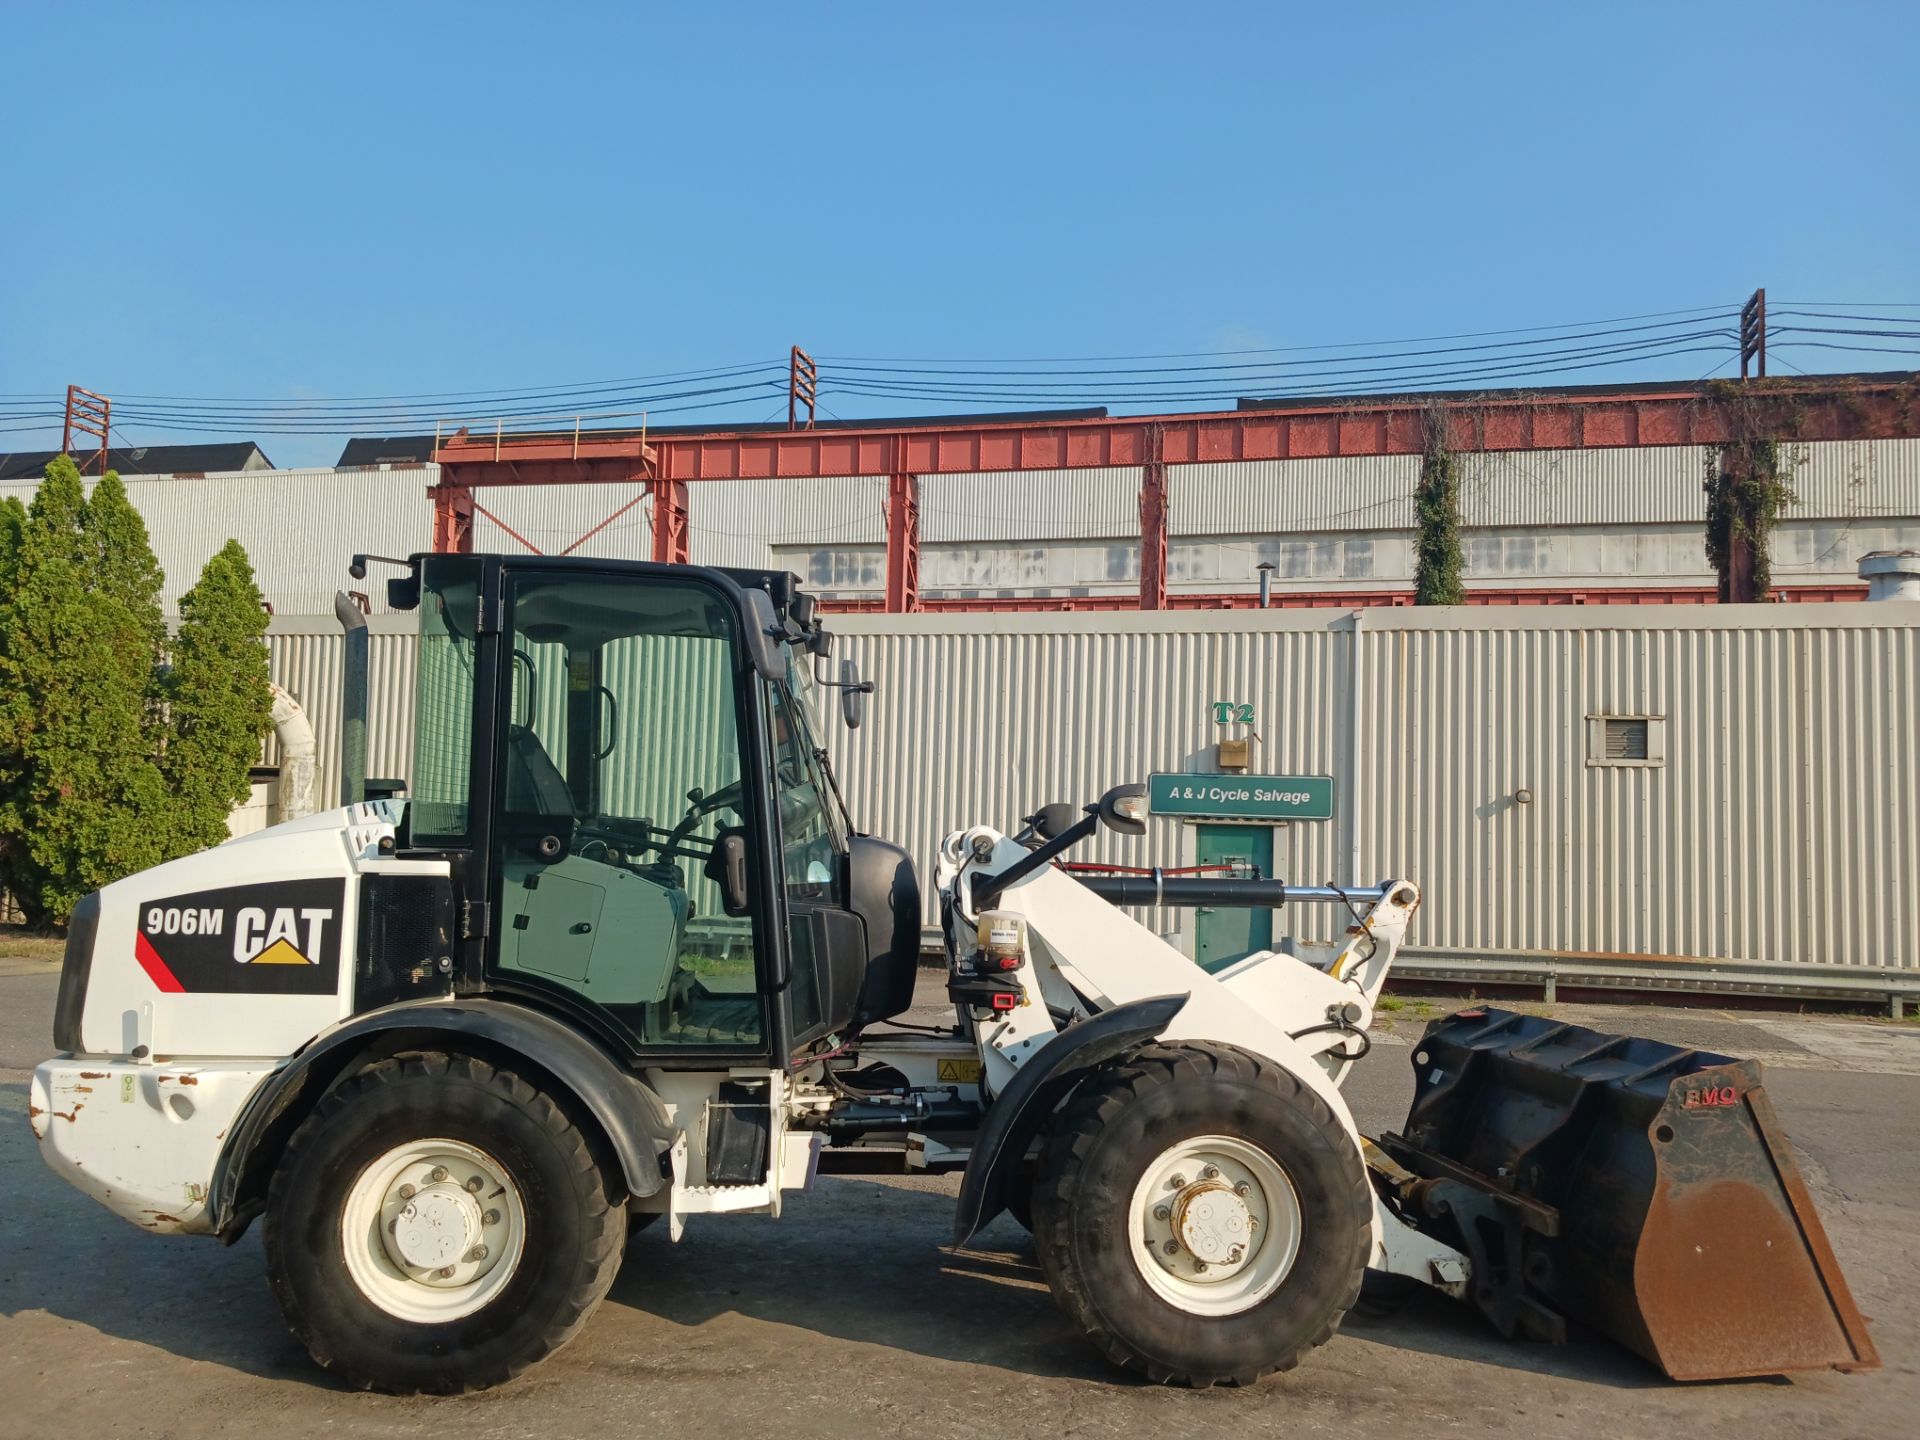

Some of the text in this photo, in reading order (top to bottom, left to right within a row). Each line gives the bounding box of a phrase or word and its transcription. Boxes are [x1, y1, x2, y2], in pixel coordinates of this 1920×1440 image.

[1169, 787, 1311, 805] A & J Cycle Salvage
[147, 907, 333, 965] 906M CAT
